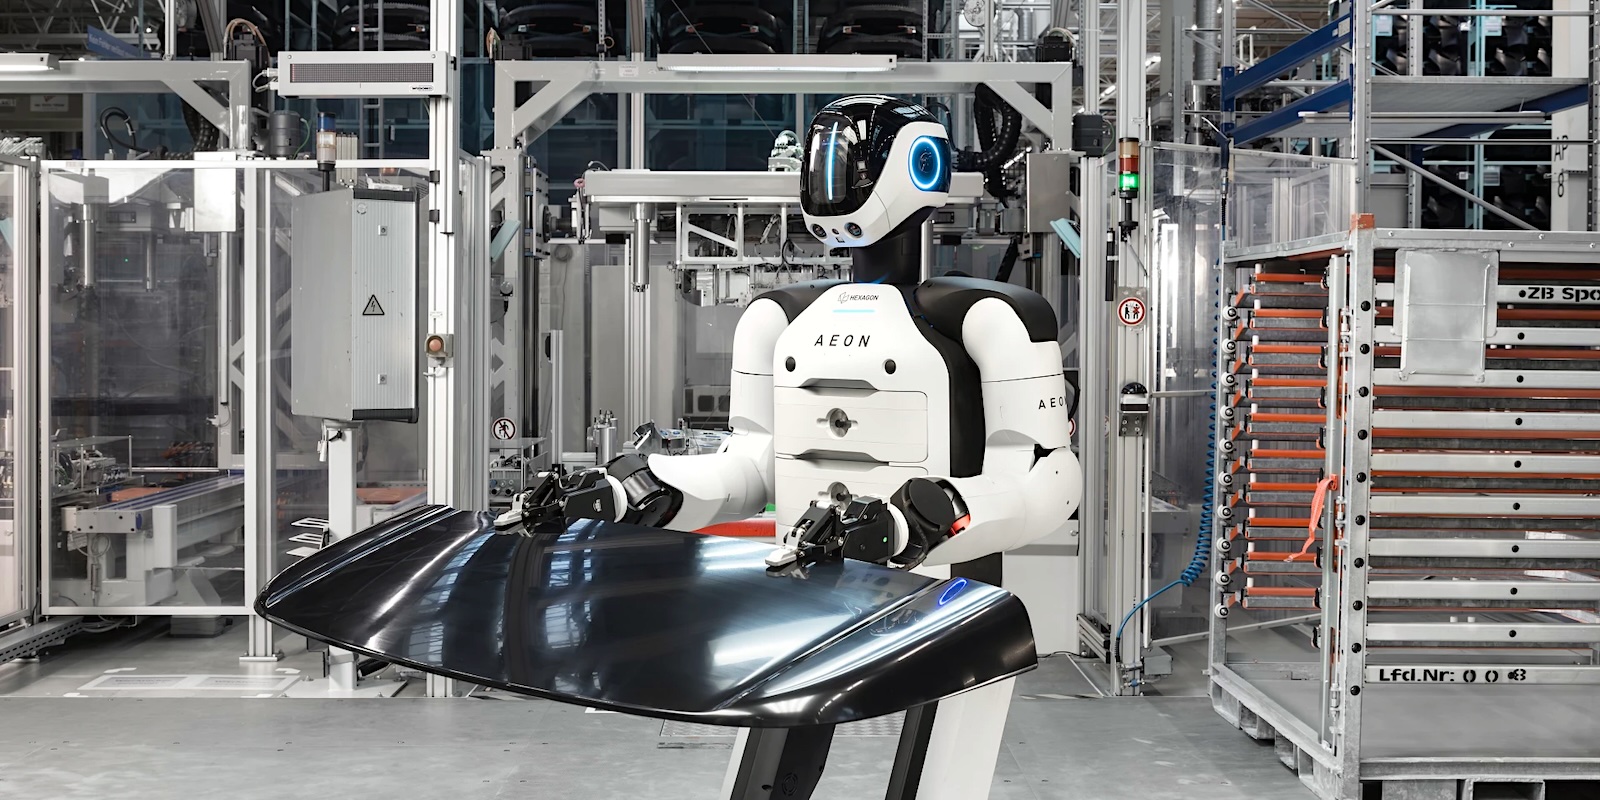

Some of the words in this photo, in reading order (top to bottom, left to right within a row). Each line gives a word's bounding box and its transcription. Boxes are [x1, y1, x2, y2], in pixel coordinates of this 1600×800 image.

[1528, 287, 1554, 299] ZB
[814, 334, 870, 347] AEON
[1379, 668, 1454, 682] Lfd.Nr:
